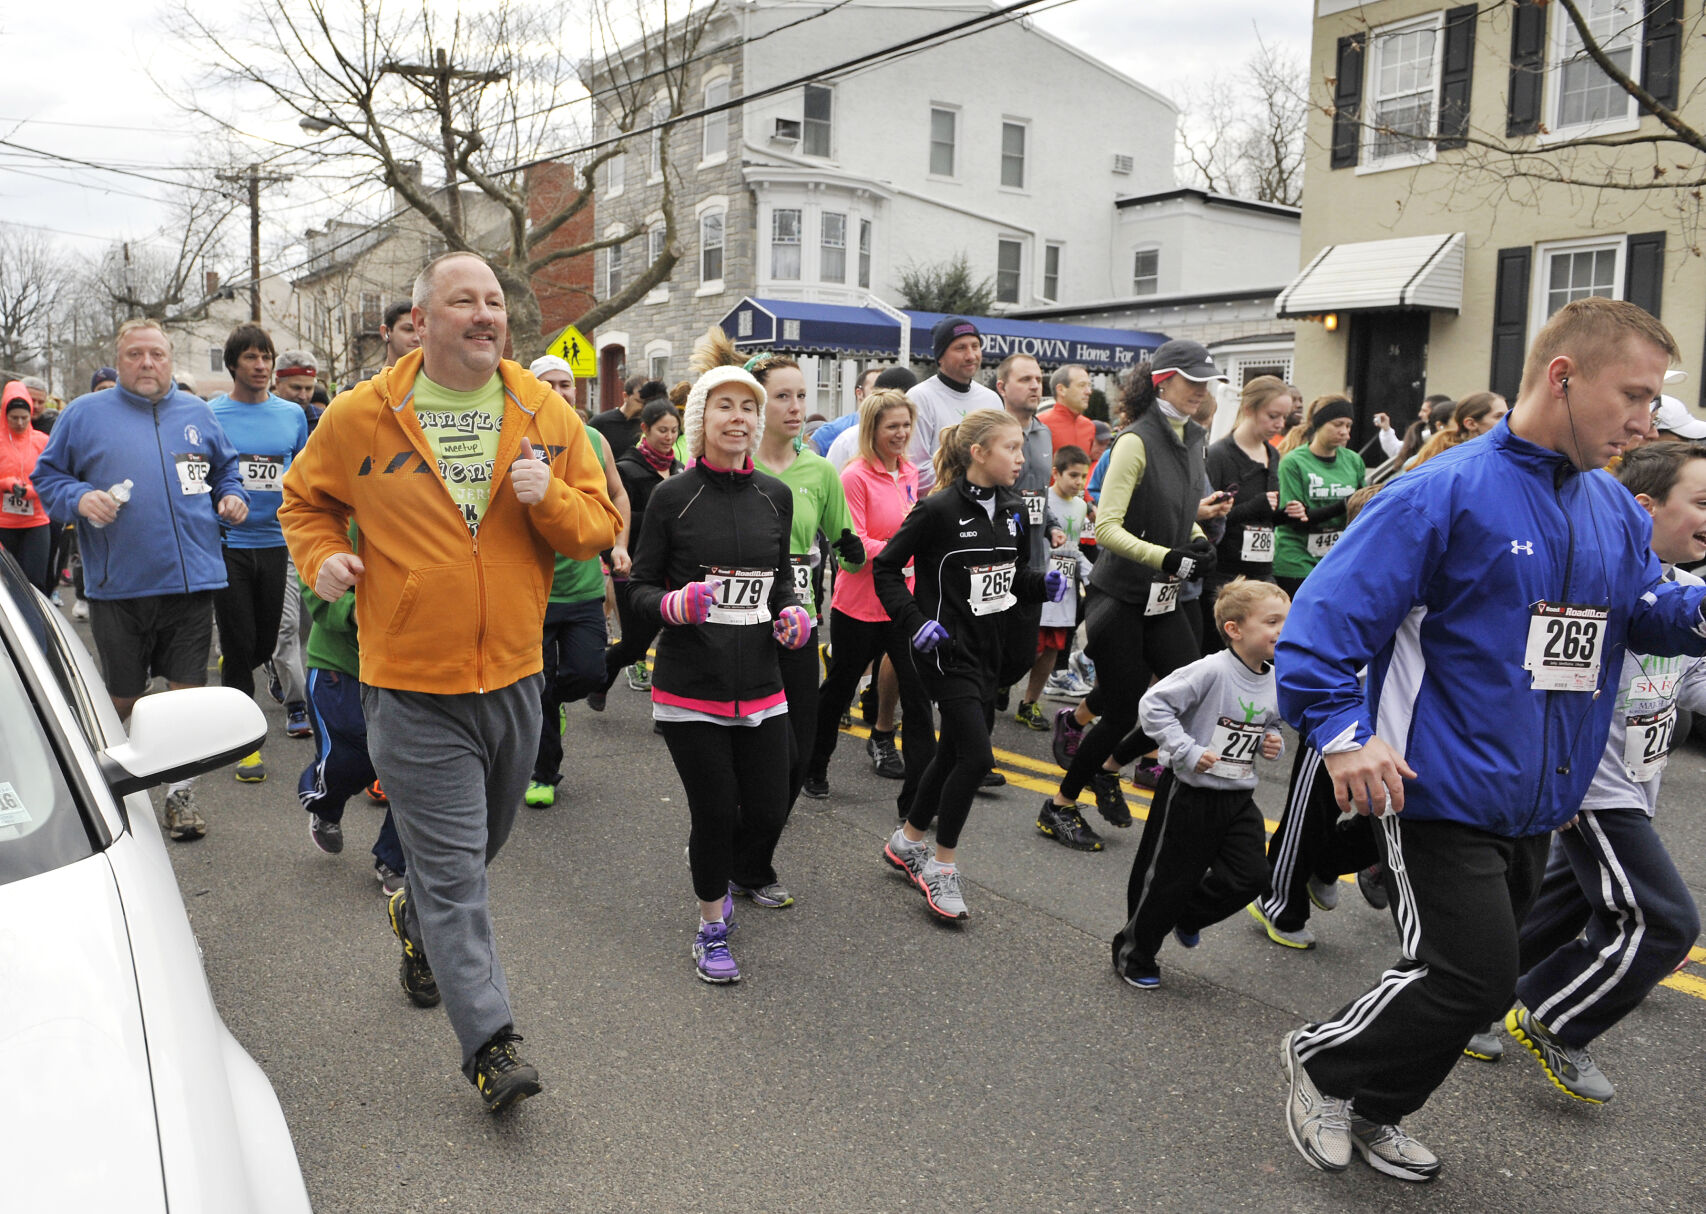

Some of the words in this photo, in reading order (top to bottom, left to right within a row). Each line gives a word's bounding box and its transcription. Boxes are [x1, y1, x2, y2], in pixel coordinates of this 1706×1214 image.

[1076, 344, 1110, 362] Home
[1115, 346, 1134, 363] For
[248, 463, 277, 480] 570
[1251, 532, 1271, 549] 286
[721, 578, 763, 605] 179
[982, 570, 1012, 597] 265
[1543, 618, 1598, 661] 263
[1221, 731, 1261, 760] 274
